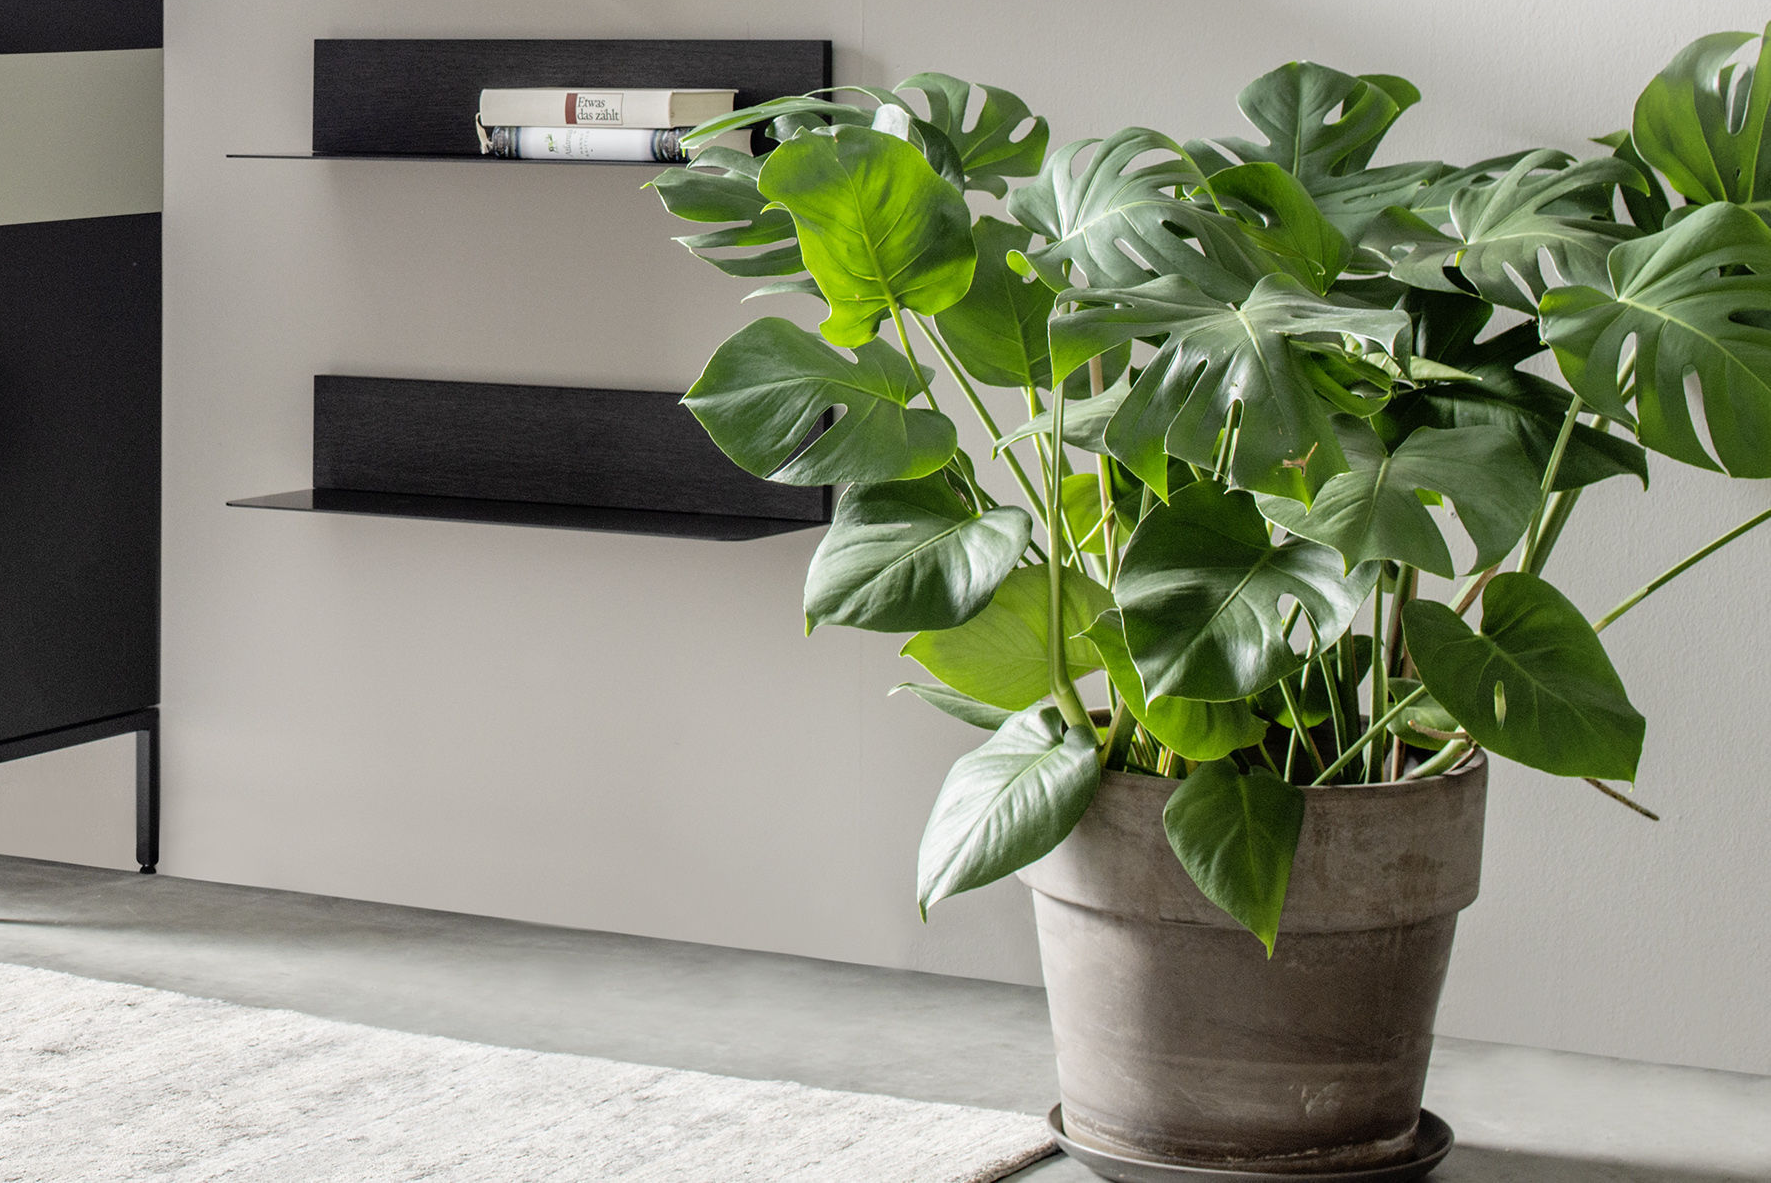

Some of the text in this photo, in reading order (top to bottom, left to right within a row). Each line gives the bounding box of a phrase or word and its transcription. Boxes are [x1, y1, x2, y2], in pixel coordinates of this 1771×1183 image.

[577, 96, 606, 108] Etwas
[577, 108, 620, 121] das zählt
